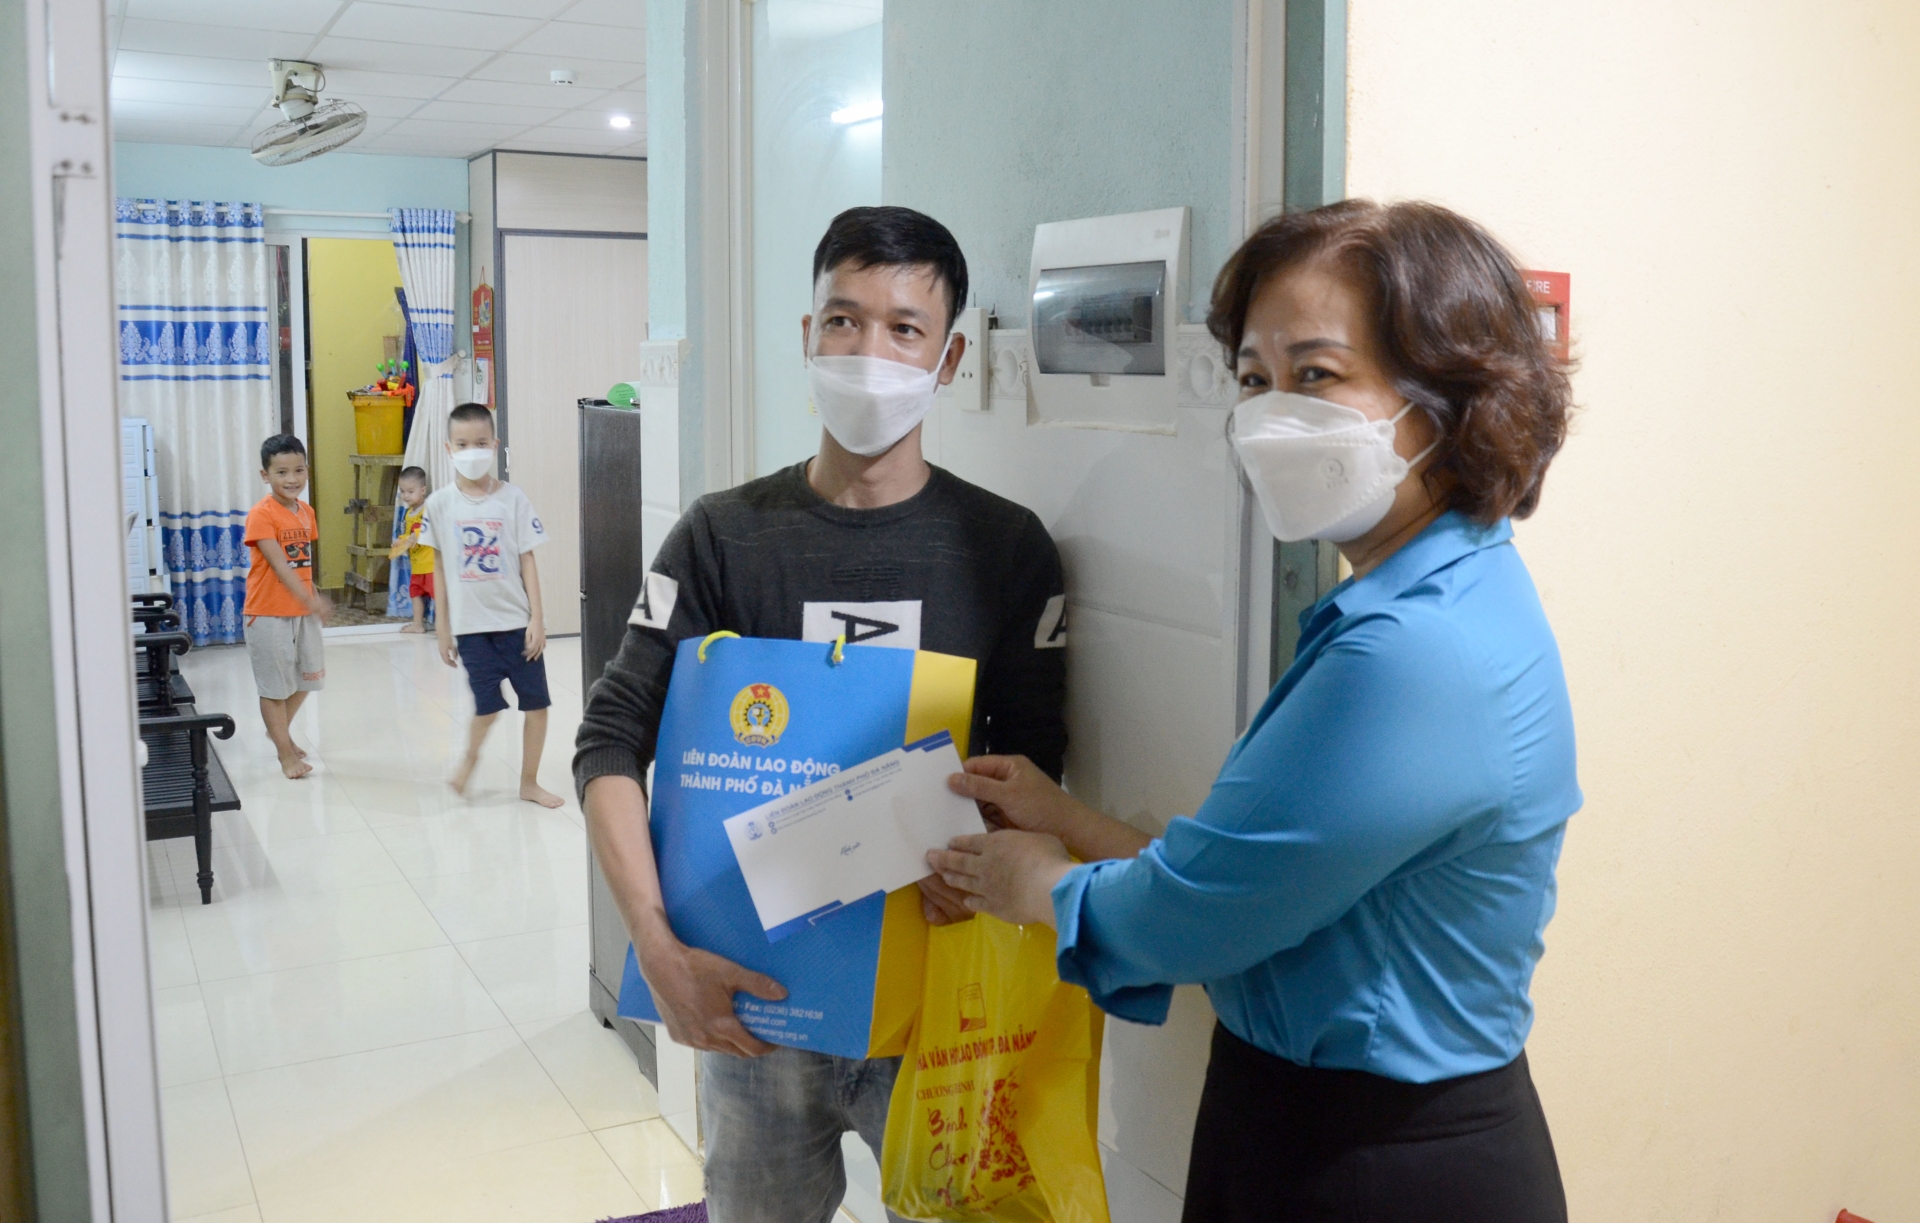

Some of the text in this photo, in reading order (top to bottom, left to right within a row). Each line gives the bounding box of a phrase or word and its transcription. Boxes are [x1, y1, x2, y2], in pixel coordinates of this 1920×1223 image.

[830, 610, 899, 645] A
[682, 748, 841, 779] LIÊN ĐOÀN LAO ĐỘNG
[680, 772, 721, 791] THÀNH
[725, 774, 759, 794] PHỐ
[761, 778, 785, 797] ĐÀ
[745, 1002, 761, 1012] Fax:
